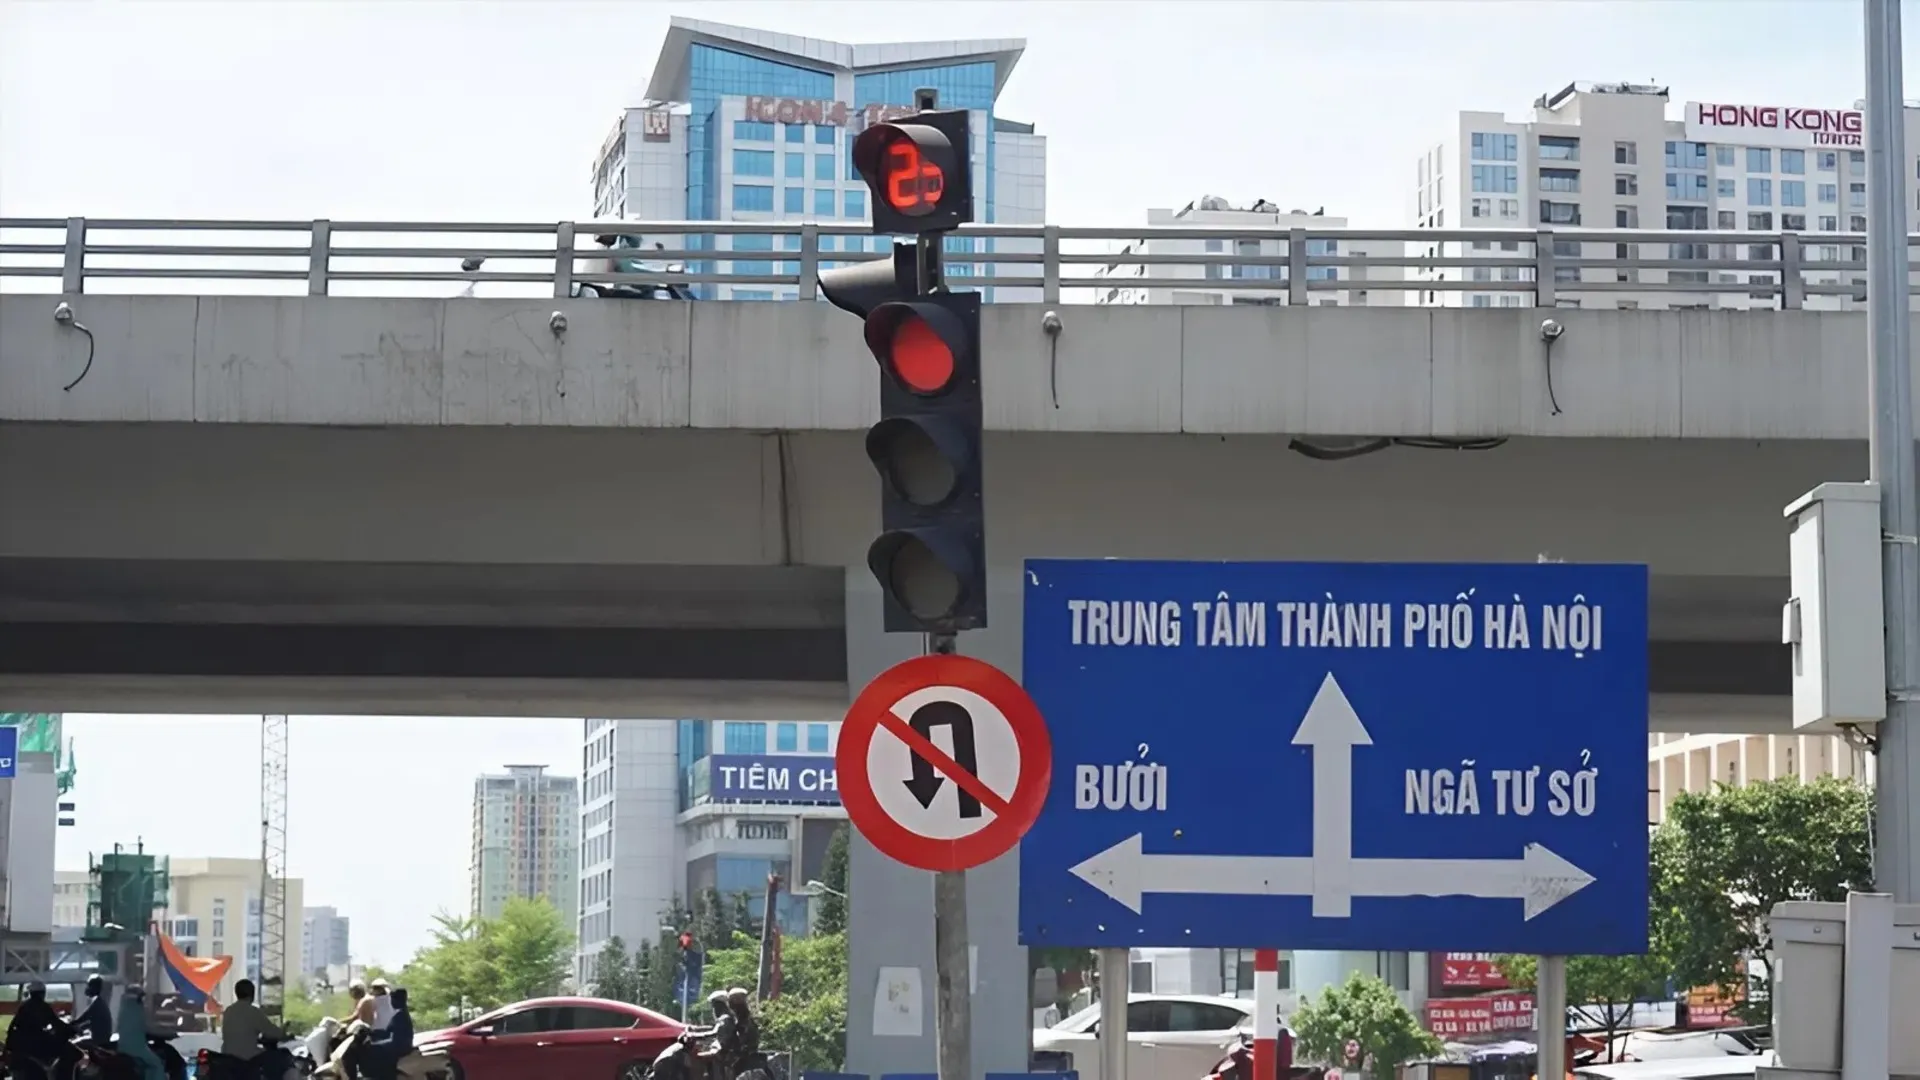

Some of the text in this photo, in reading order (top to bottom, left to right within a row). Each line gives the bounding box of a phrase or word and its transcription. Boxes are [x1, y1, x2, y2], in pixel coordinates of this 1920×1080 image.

[1699, 103, 1862, 132] HONG KONG
[1068, 587, 1602, 658] TRUNG TÂM THÀNH PHỐ HÀ NỘI
[719, 762, 838, 792] TIÊM CH
[1075, 742, 1167, 811] BƯỞI
[1405, 748, 1598, 816] NGÃ TƯ SỞ
